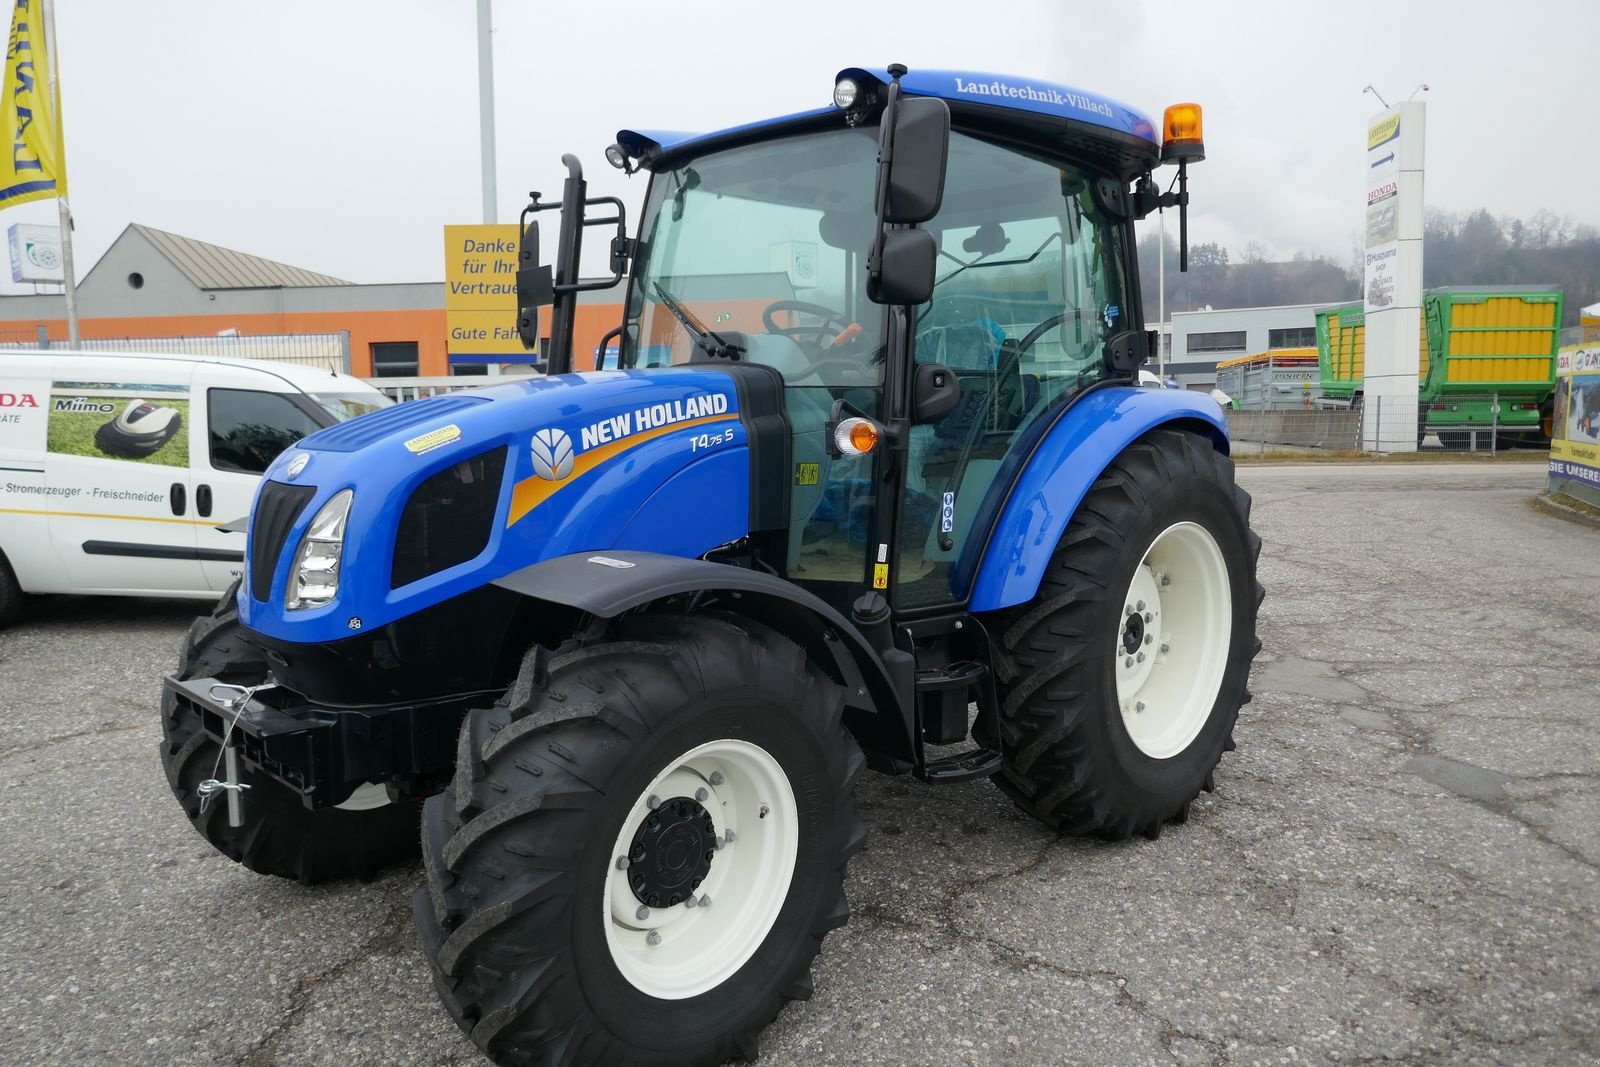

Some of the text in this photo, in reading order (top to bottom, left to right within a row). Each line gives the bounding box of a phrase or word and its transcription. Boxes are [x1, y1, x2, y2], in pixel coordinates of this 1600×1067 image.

[954, 78, 1113, 118] Landtechnik-Villach
[1368, 182, 1397, 200] HONDA
[464, 239, 515, 253] Danke
[463, 259, 515, 274] für Ihr
[450, 281, 518, 295] Vertraue
[451, 326, 522, 340] Gute Fah
[55, 397, 115, 413] Miimo
[581, 393, 728, 450] NEW HOLLAND
[690, 429, 734, 452] T4.75 S
[1549, 461, 1600, 482] SIE UNSERE
[6, 482, 82, 498] Stromerzeuger
[92, 487, 164, 503] Freischneider
